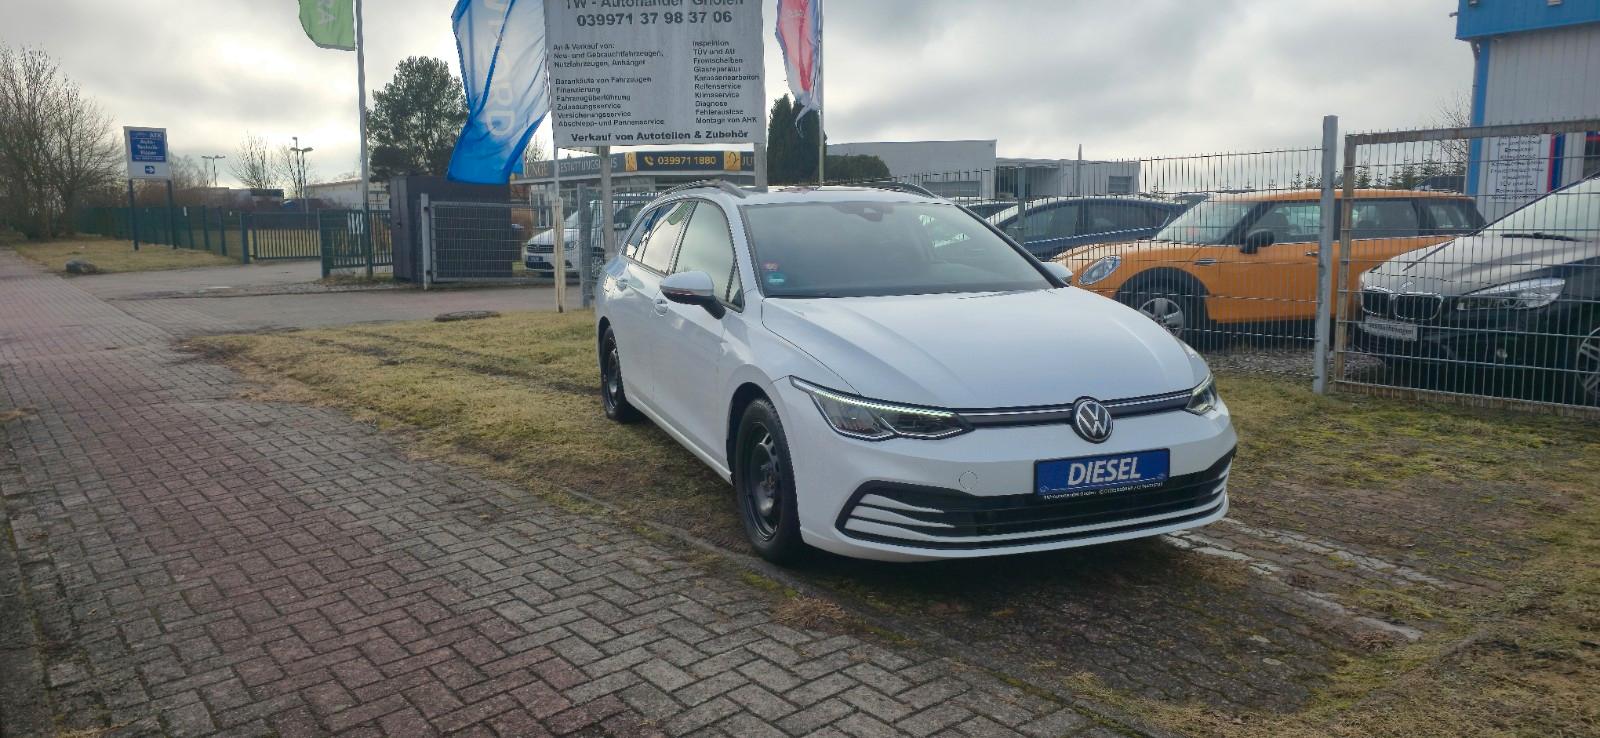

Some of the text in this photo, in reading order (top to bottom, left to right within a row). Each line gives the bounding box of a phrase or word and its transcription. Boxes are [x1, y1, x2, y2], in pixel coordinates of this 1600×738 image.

[576, 10, 733, 26] 039971 37 98 37 06
[571, 42, 598, 50] Verkauf
[556, 86, 601, 94] Finanzierung
[695, 100, 728, 108] Diagnose
[570, 129, 749, 142] Verkauf von Autoteilen & Zubehör
[657, 155, 717, 166] 039971 1880
[1076, 400, 1111, 440] VW
[1067, 456, 1141, 486] DIESEL
